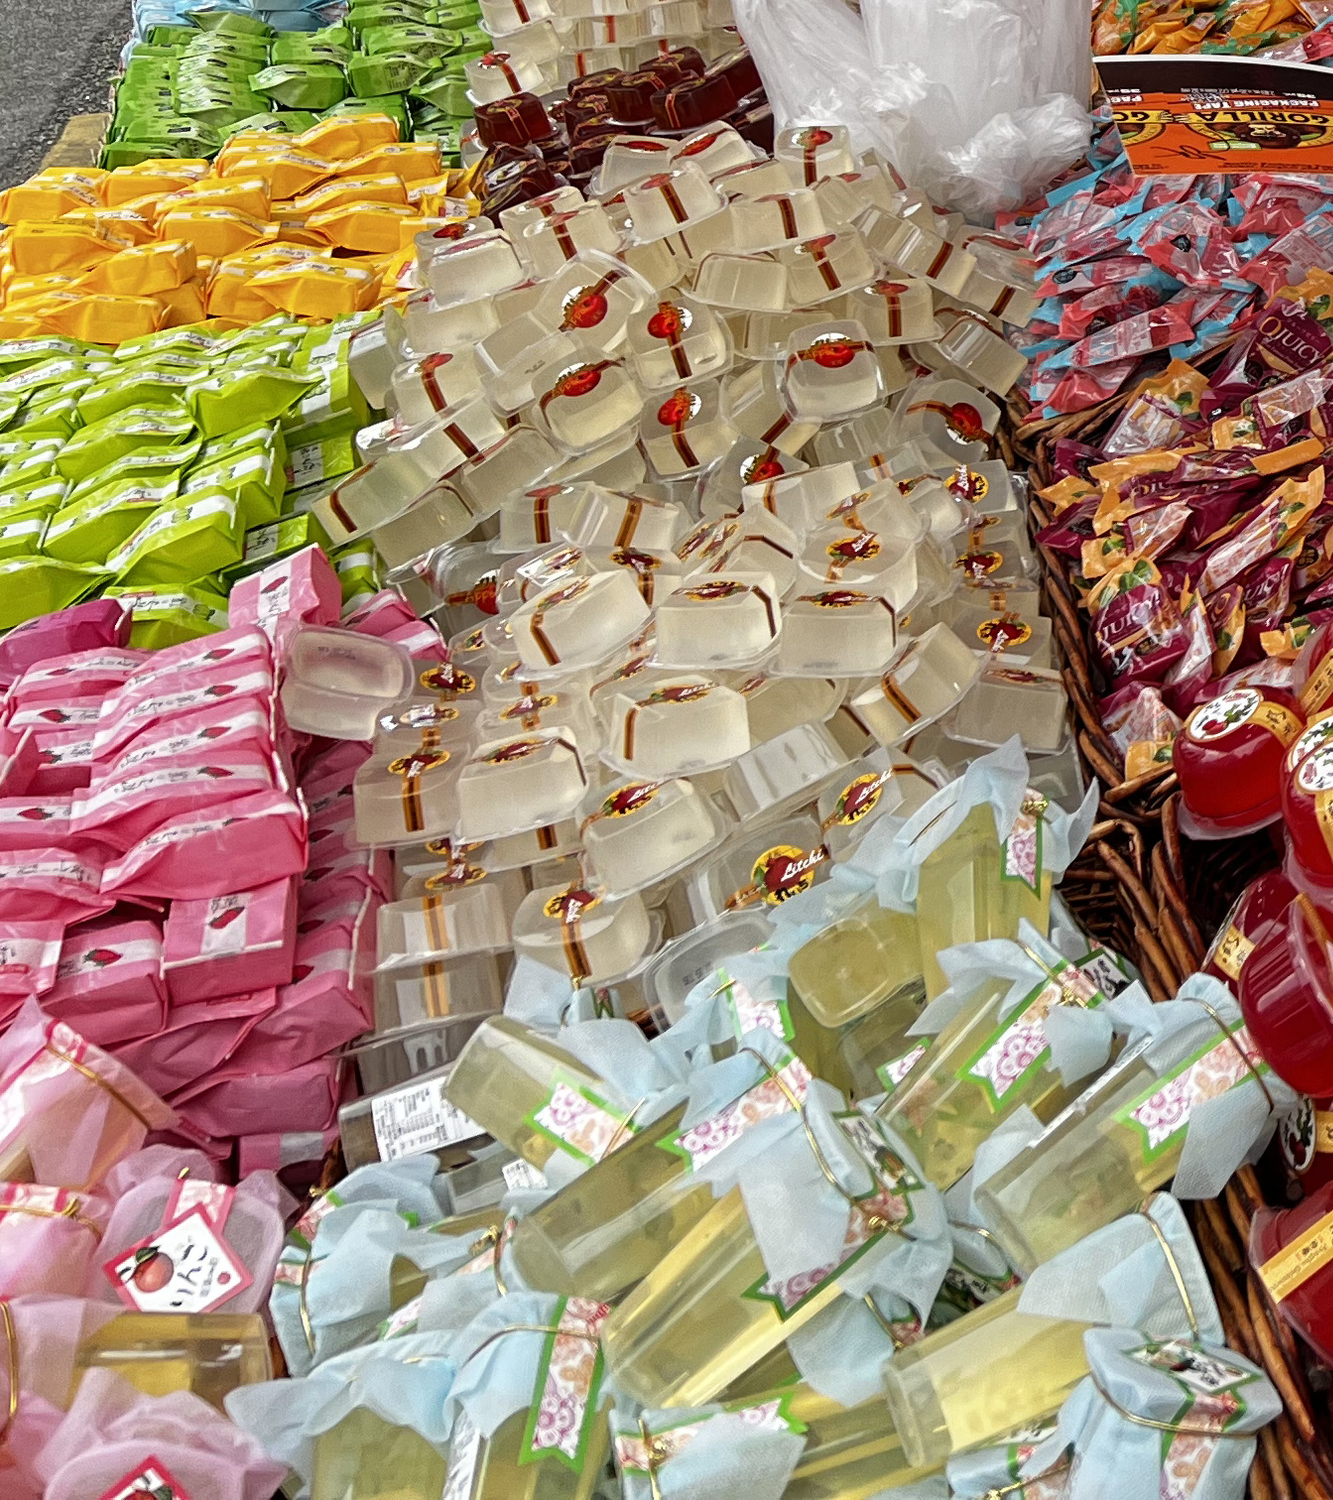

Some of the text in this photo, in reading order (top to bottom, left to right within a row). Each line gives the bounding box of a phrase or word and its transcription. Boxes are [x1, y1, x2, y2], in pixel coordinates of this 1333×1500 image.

[1189, 108, 1332, 130] GORILLA
[855, 770, 892, 805] Litchi
[781, 848, 826, 883] Litchi
